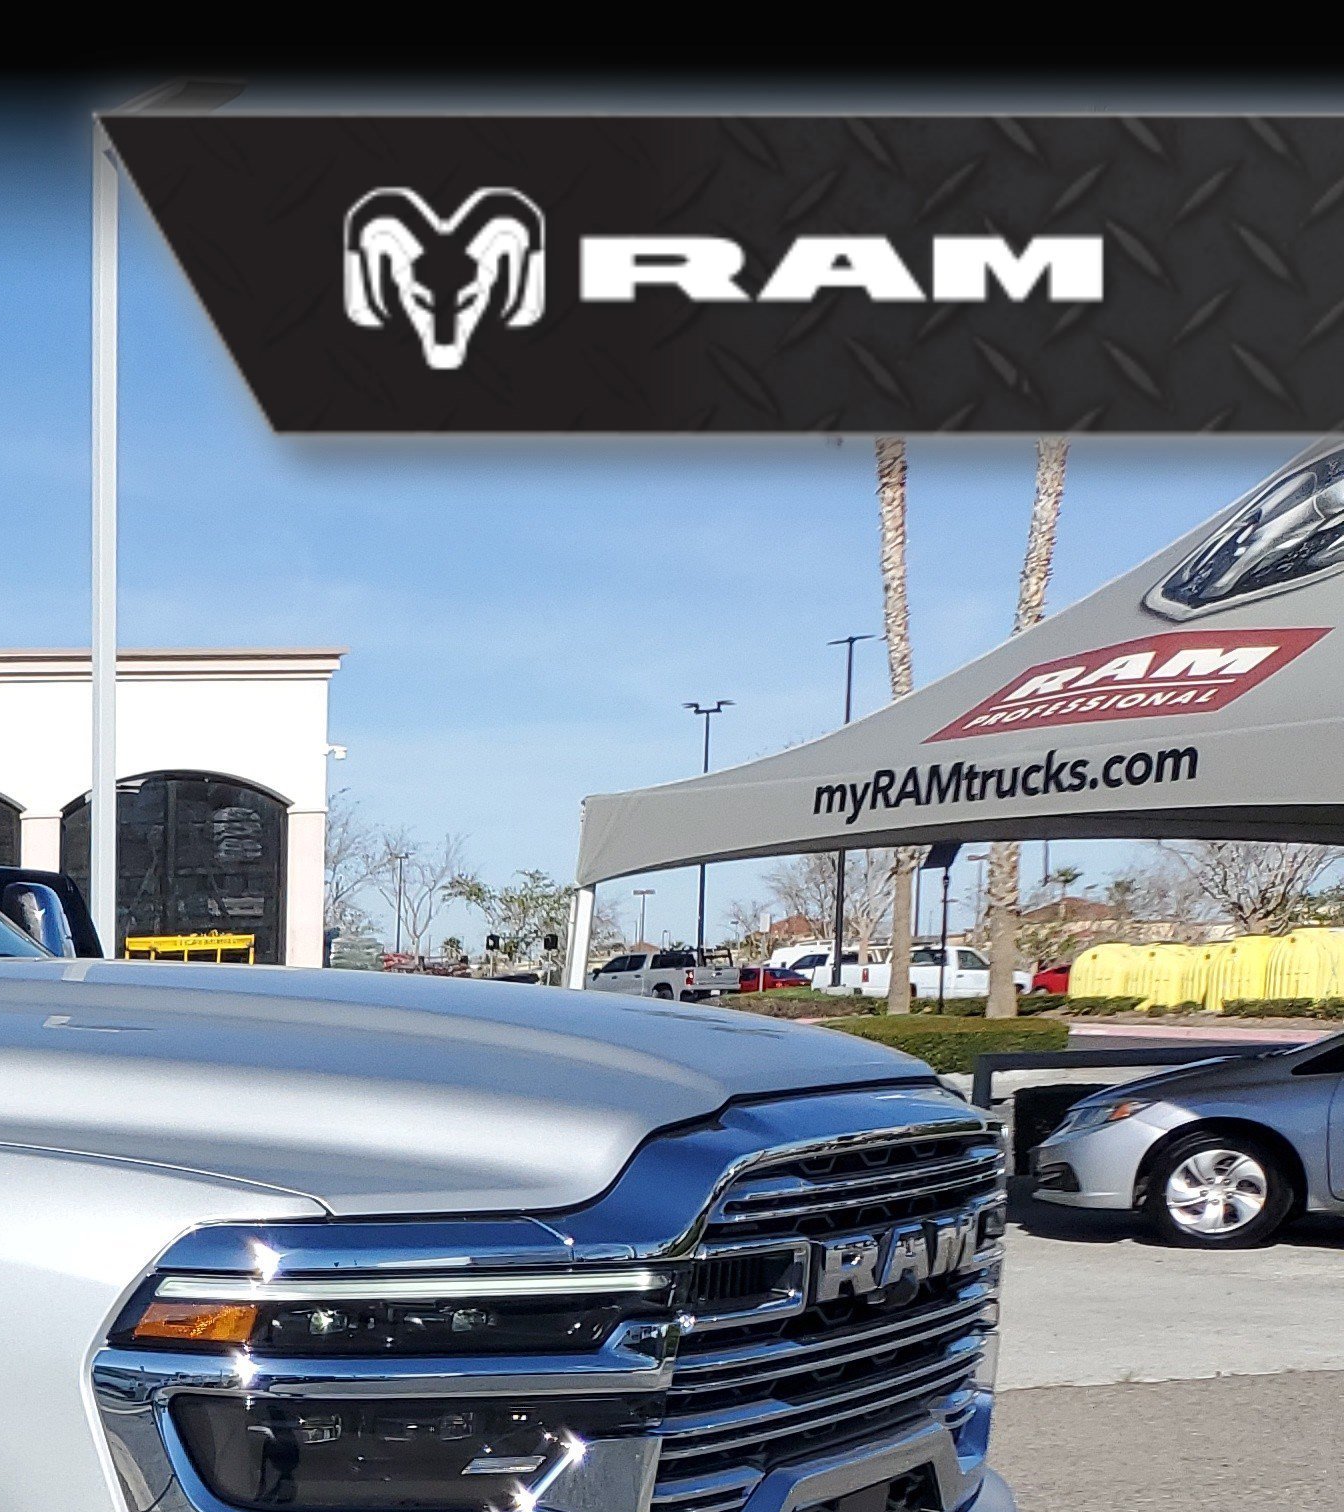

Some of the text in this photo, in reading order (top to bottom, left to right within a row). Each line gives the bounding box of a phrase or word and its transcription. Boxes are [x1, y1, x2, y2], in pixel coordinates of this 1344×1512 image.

[1008, 645, 1281, 700] RAM
[962, 687, 1221, 731] PROFESSIONAL
[812, 745, 1200, 825] myRAMtrucks.com
[816, 1214, 981, 1303] RAM
